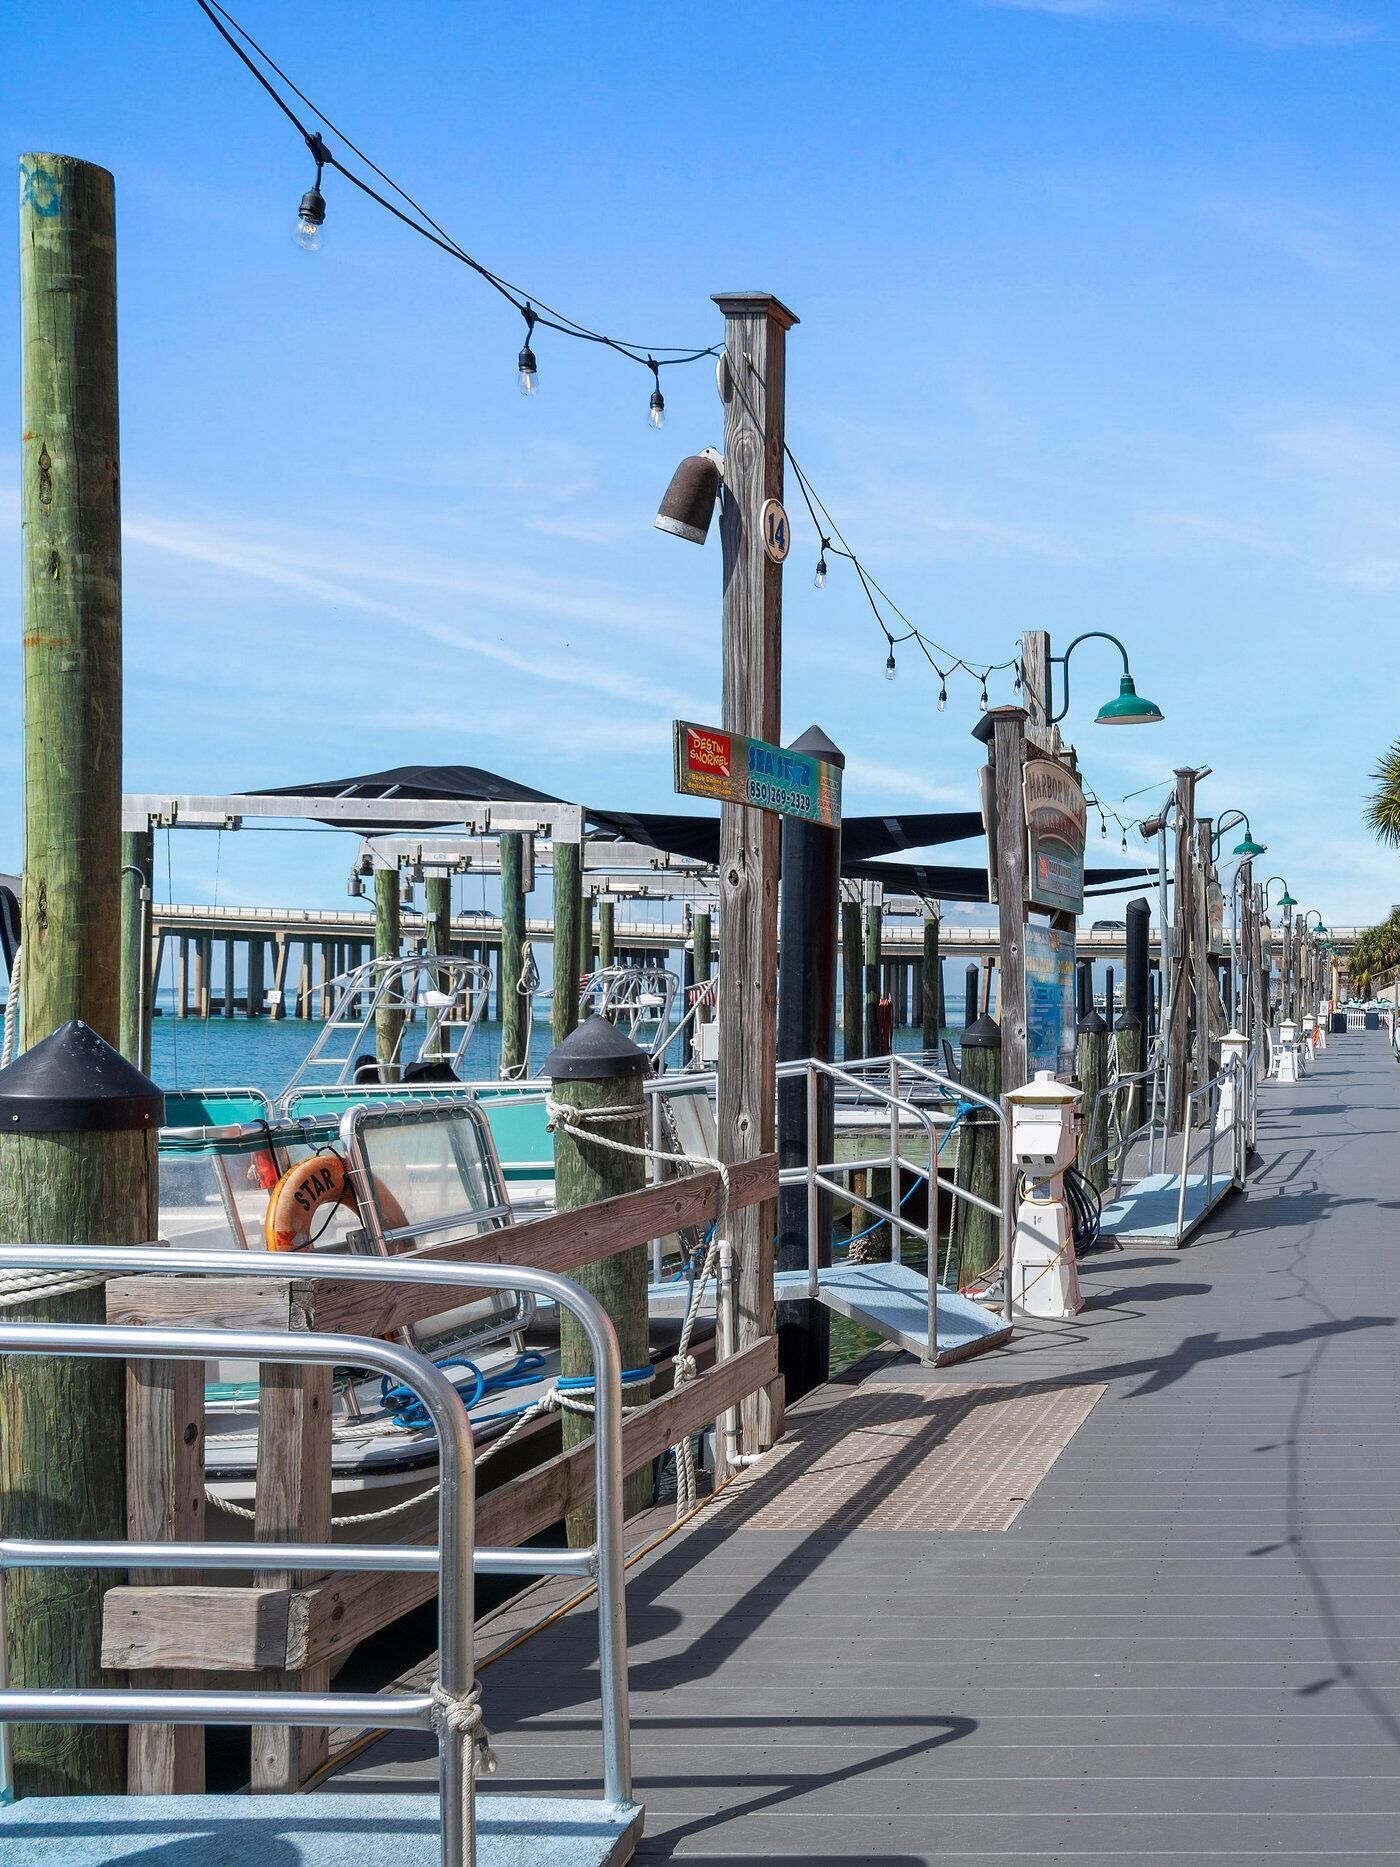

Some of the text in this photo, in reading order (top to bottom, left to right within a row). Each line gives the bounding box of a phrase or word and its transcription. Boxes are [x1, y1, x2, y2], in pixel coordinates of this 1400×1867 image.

[768, 511, 785, 554] 14
[690, 748, 729, 767] SNORKEL
[693, 738, 724, 755] DESTIN
[294, 1168, 334, 1211] STAR
